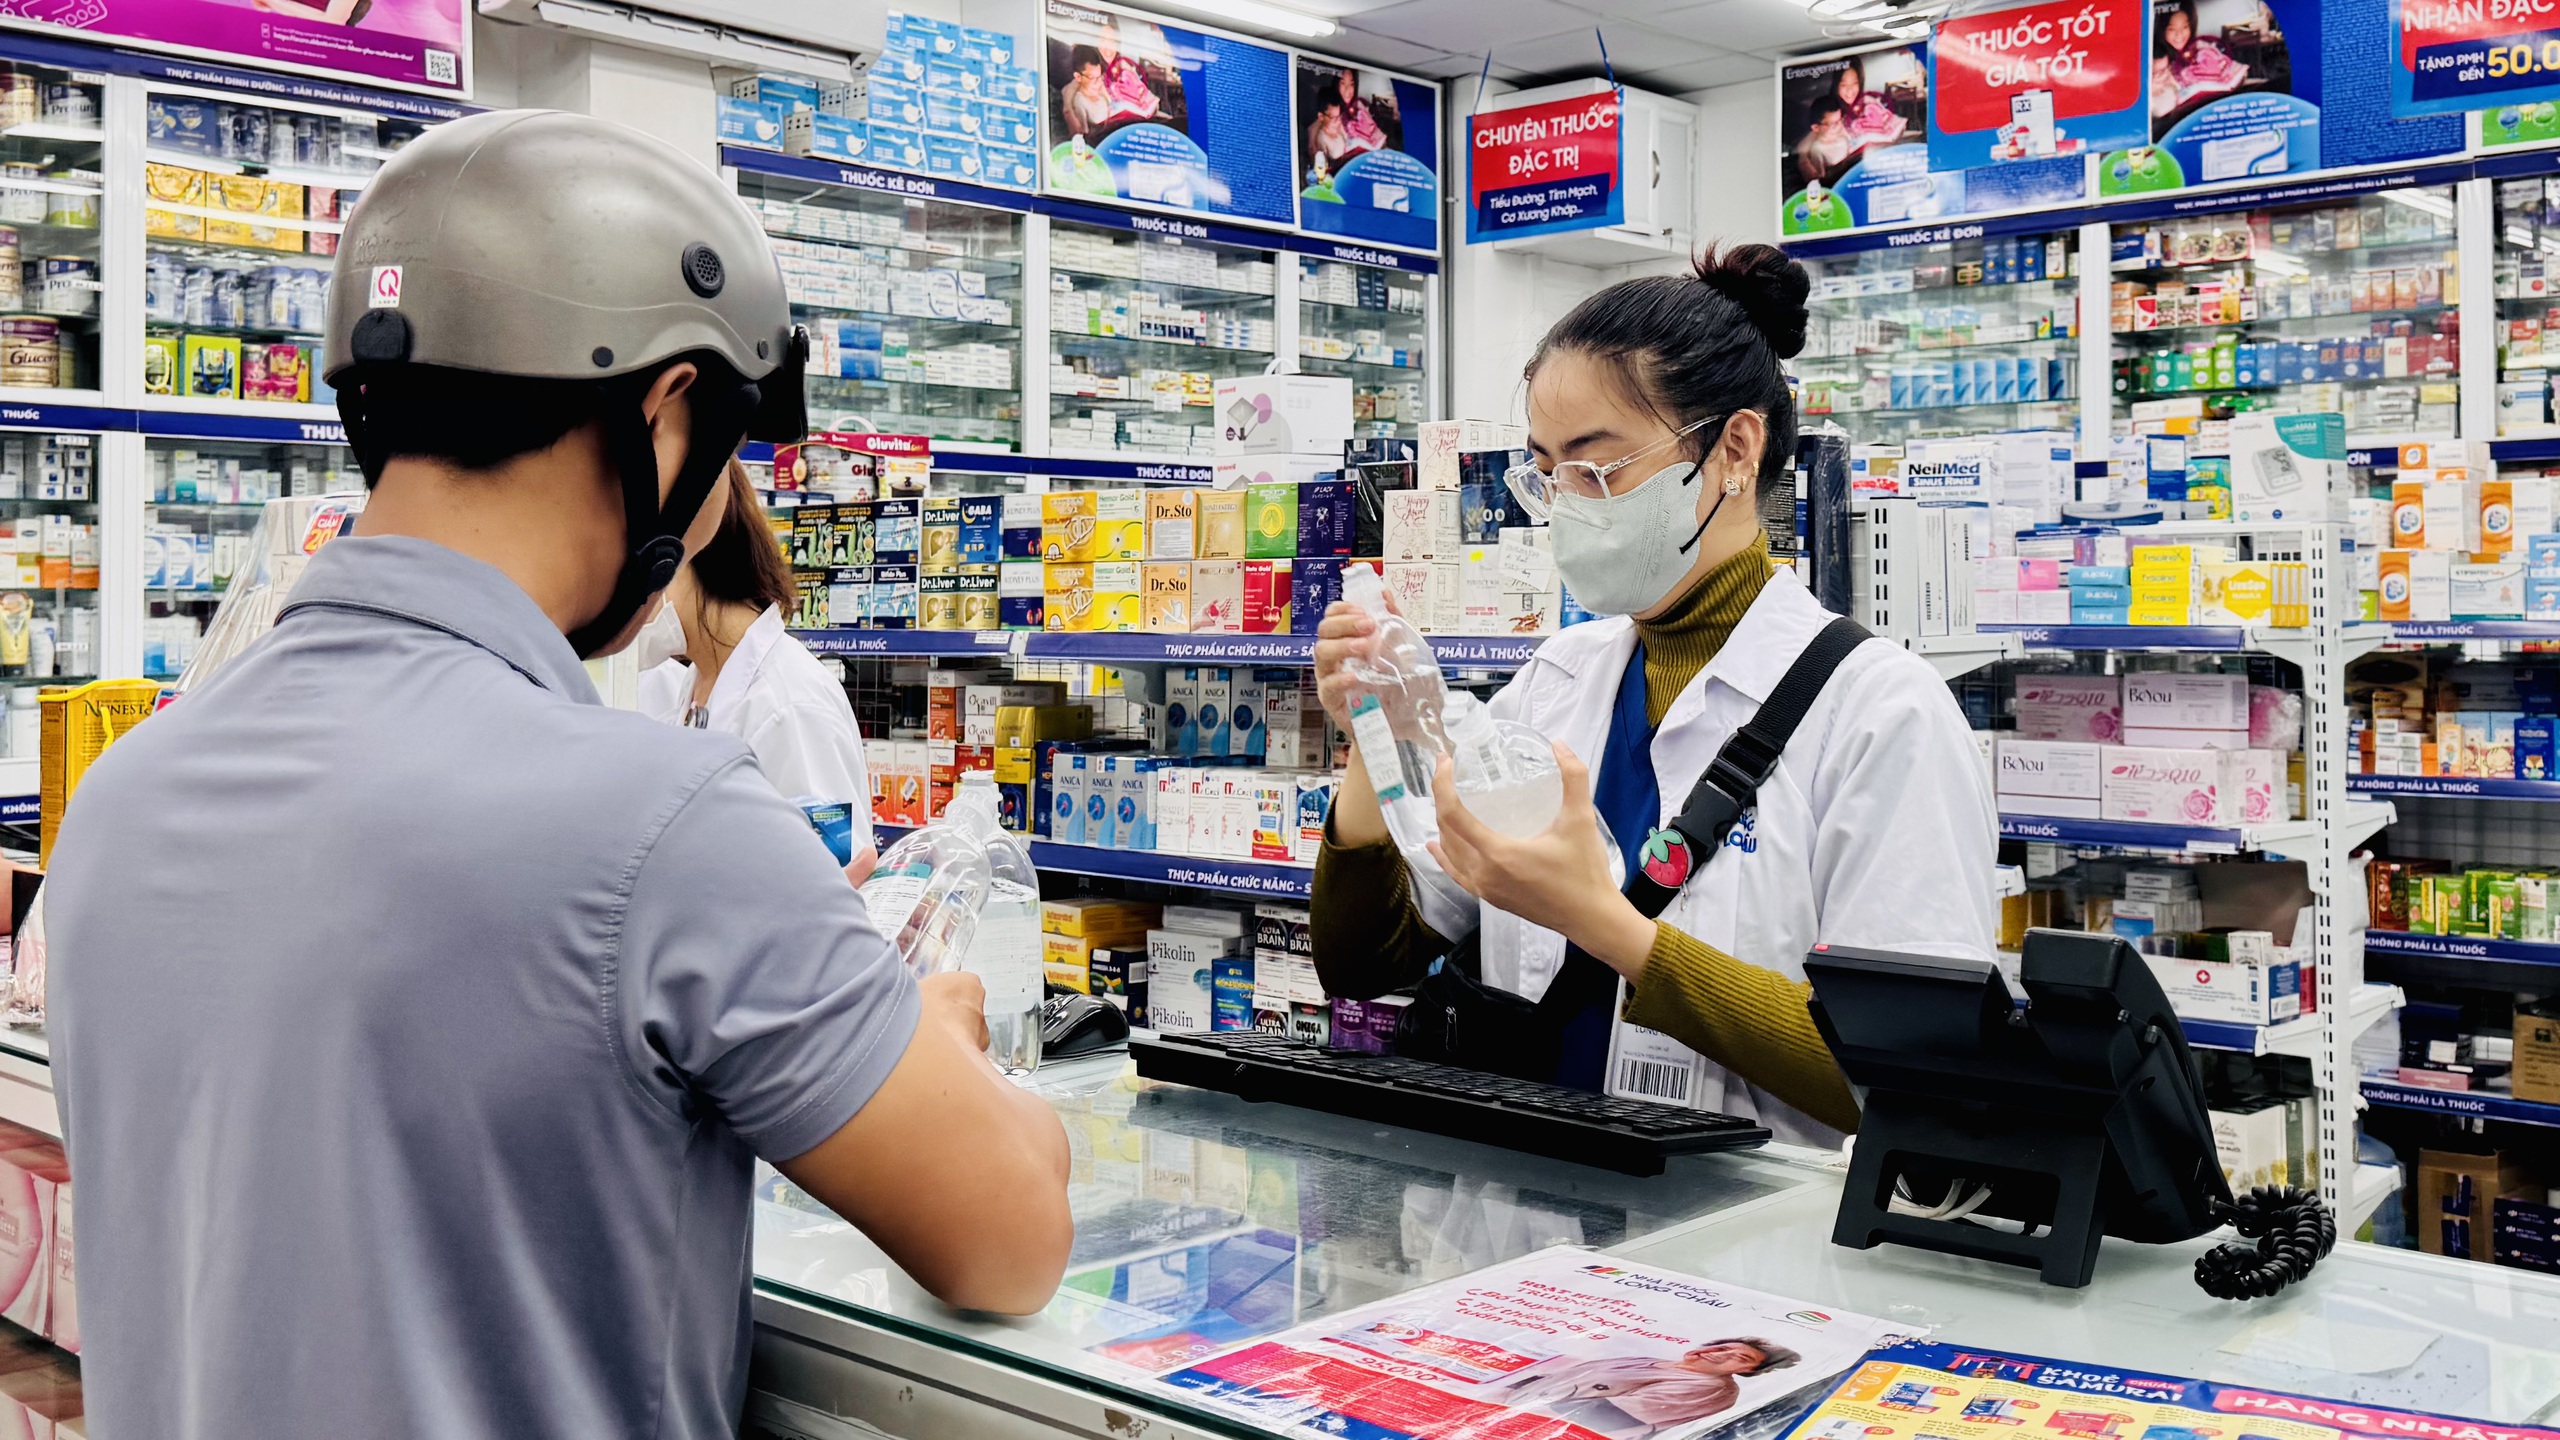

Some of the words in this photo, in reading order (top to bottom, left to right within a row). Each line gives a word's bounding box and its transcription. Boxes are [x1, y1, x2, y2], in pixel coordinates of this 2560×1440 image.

[1965, 14, 2052, 53] THUỐC
[2058, 4, 2111, 41] TỐT
[1985, 54, 2030, 87] GIÁ
[2036, 44, 2089, 81] TỐT
[2419, 55, 2454, 73] TẶNG
[2456, 52, 2485, 66] PMH
[2458, 65, 2485, 82] ĐẾN
[1476, 117, 1547, 149] CHUYÊN
[1550, 102, 1614, 136] THUỐC
[1509, 148, 1549, 179] ĐẶC
[1552, 146, 1580, 171] TRỊ
[840, 167, 886, 190] THUỐC
[887, 173, 905, 192] KÊ
[906, 178, 936, 196] ĐƠN
[1490, 193, 1512, 209] Tiểu
[1548, 188, 1567, 201] Tim
[1501, 212, 1517, 224] Cơ
[1517, 208, 1550, 222] Xương
[1131, 214, 1167, 234] THUỐC
[1169, 219, 1183, 235] KÊ
[1184, 221, 1208, 238] ĐƠN
[1888, 227, 1932, 247] THUỐC
[1933, 229, 1951, 245] KÊ
[1952, 226, 1984, 239] ĐƠN
[1333, 244, 1363, 262] THUỐC
[1364, 248, 1378, 264] KÊ
[1378, 251, 1398, 267] ĐƠN
[2, 408, 40, 420] THUỐC
[866, 436, 911, 451] Gluvita
[2347, 451, 2372, 465] ƠN
[1136, 462, 1172, 479] THUỐC
[1173, 464, 1188, 480] KÊ
[1189, 467, 1212, 481] ĐƠN
[1908, 463, 1980, 475] NeilMed
[1914, 477, 1944, 487] SINUS
[1945, 476, 1976, 486] RINSE
[924, 511, 959, 523] Dr.Liver
[968, 504, 992, 516] GABA
[1156, 504, 1192, 518] Dr.Sto
[921, 577, 956, 589] Dr.Liver
[960, 575, 995, 588] Dr.Liver
[1150, 578, 1187, 592] Dr.Sto
[2437, 625, 2474, 636] THUỐC
[826, 638, 846, 650] PHẢI
[847, 637, 858, 650] LÀ
[858, 637, 888, 650] THUỐC
[1165, 642, 1193, 658] THỰC
[1194, 641, 1226, 657] PHẨM
[1227, 642, 1258, 657] CHỨC
[1259, 642, 1291, 657] NĂNG
[1437, 643, 1467, 658] PHẢI
[1470, 644, 1487, 658] LÀ
[1490, 644, 1534, 660] THUỐC
[1173, 687, 1194, 697] ANICA
[1205, 688, 1226, 698] ANICA
[1240, 689, 1262, 699] ANICA
[2129, 686, 2172, 703] BeYou
[2003, 755, 2044, 772] BeYou
[1060, 775, 1081, 786] ANICA
[1092, 777, 1113, 788] ANICA
[1121, 779, 1143, 790] ANICA
[2357, 779, 2395, 790] KHÔNG
[2397, 780, 2423, 791] PHẢI
[2425, 781, 2440, 791] LÀ
[2442, 781, 2480, 793] THUỐC
[1300, 807, 1320, 819] Bone
[2018, 821, 2059, 837] THUỐC
[1167, 868, 1195, 883] THỰC
[1197, 870, 1229, 886] PHẨM
[1231, 874, 1261, 889] CHỨC
[1263, 877, 1294, 892] NĂNG
[1262, 926, 1281, 936] ULTRA
[1257, 934, 1286, 947] BRAIN
[2365, 936, 2401, 949] KHÔNG
[2403, 939, 2430, 951] PHẢI
[2432, 940, 2446, 952] LÀ
[2449, 941, 2487, 956] THUỐC
[1152, 942, 1196, 964] Pikolin
[1152, 1007, 1194, 1029] Pikolin
[1259, 1017, 1280, 1027] ULTRA
[1255, 1025, 1286, 1037] BRAIN
[1295, 1019, 1322, 1034] OMEGA
[2363, 1089, 2400, 1102] KHÔNG
[2403, 1092, 2429, 1106] PHẢI
[2431, 1095, 2445, 1107] LÀ
[2448, 1096, 2486, 1112] THUỐC
[1630, 1272, 1663, 1285] NHÀ
[1665, 1280, 1720, 1297] THUỐC
[1613, 1277, 1670, 1294] LONG
[1674, 1290, 1734, 1309] CHÂU
[2036, 1375, 2184, 1402] SAMURAI
[2234, 1395, 2369, 1427] HÀNG
